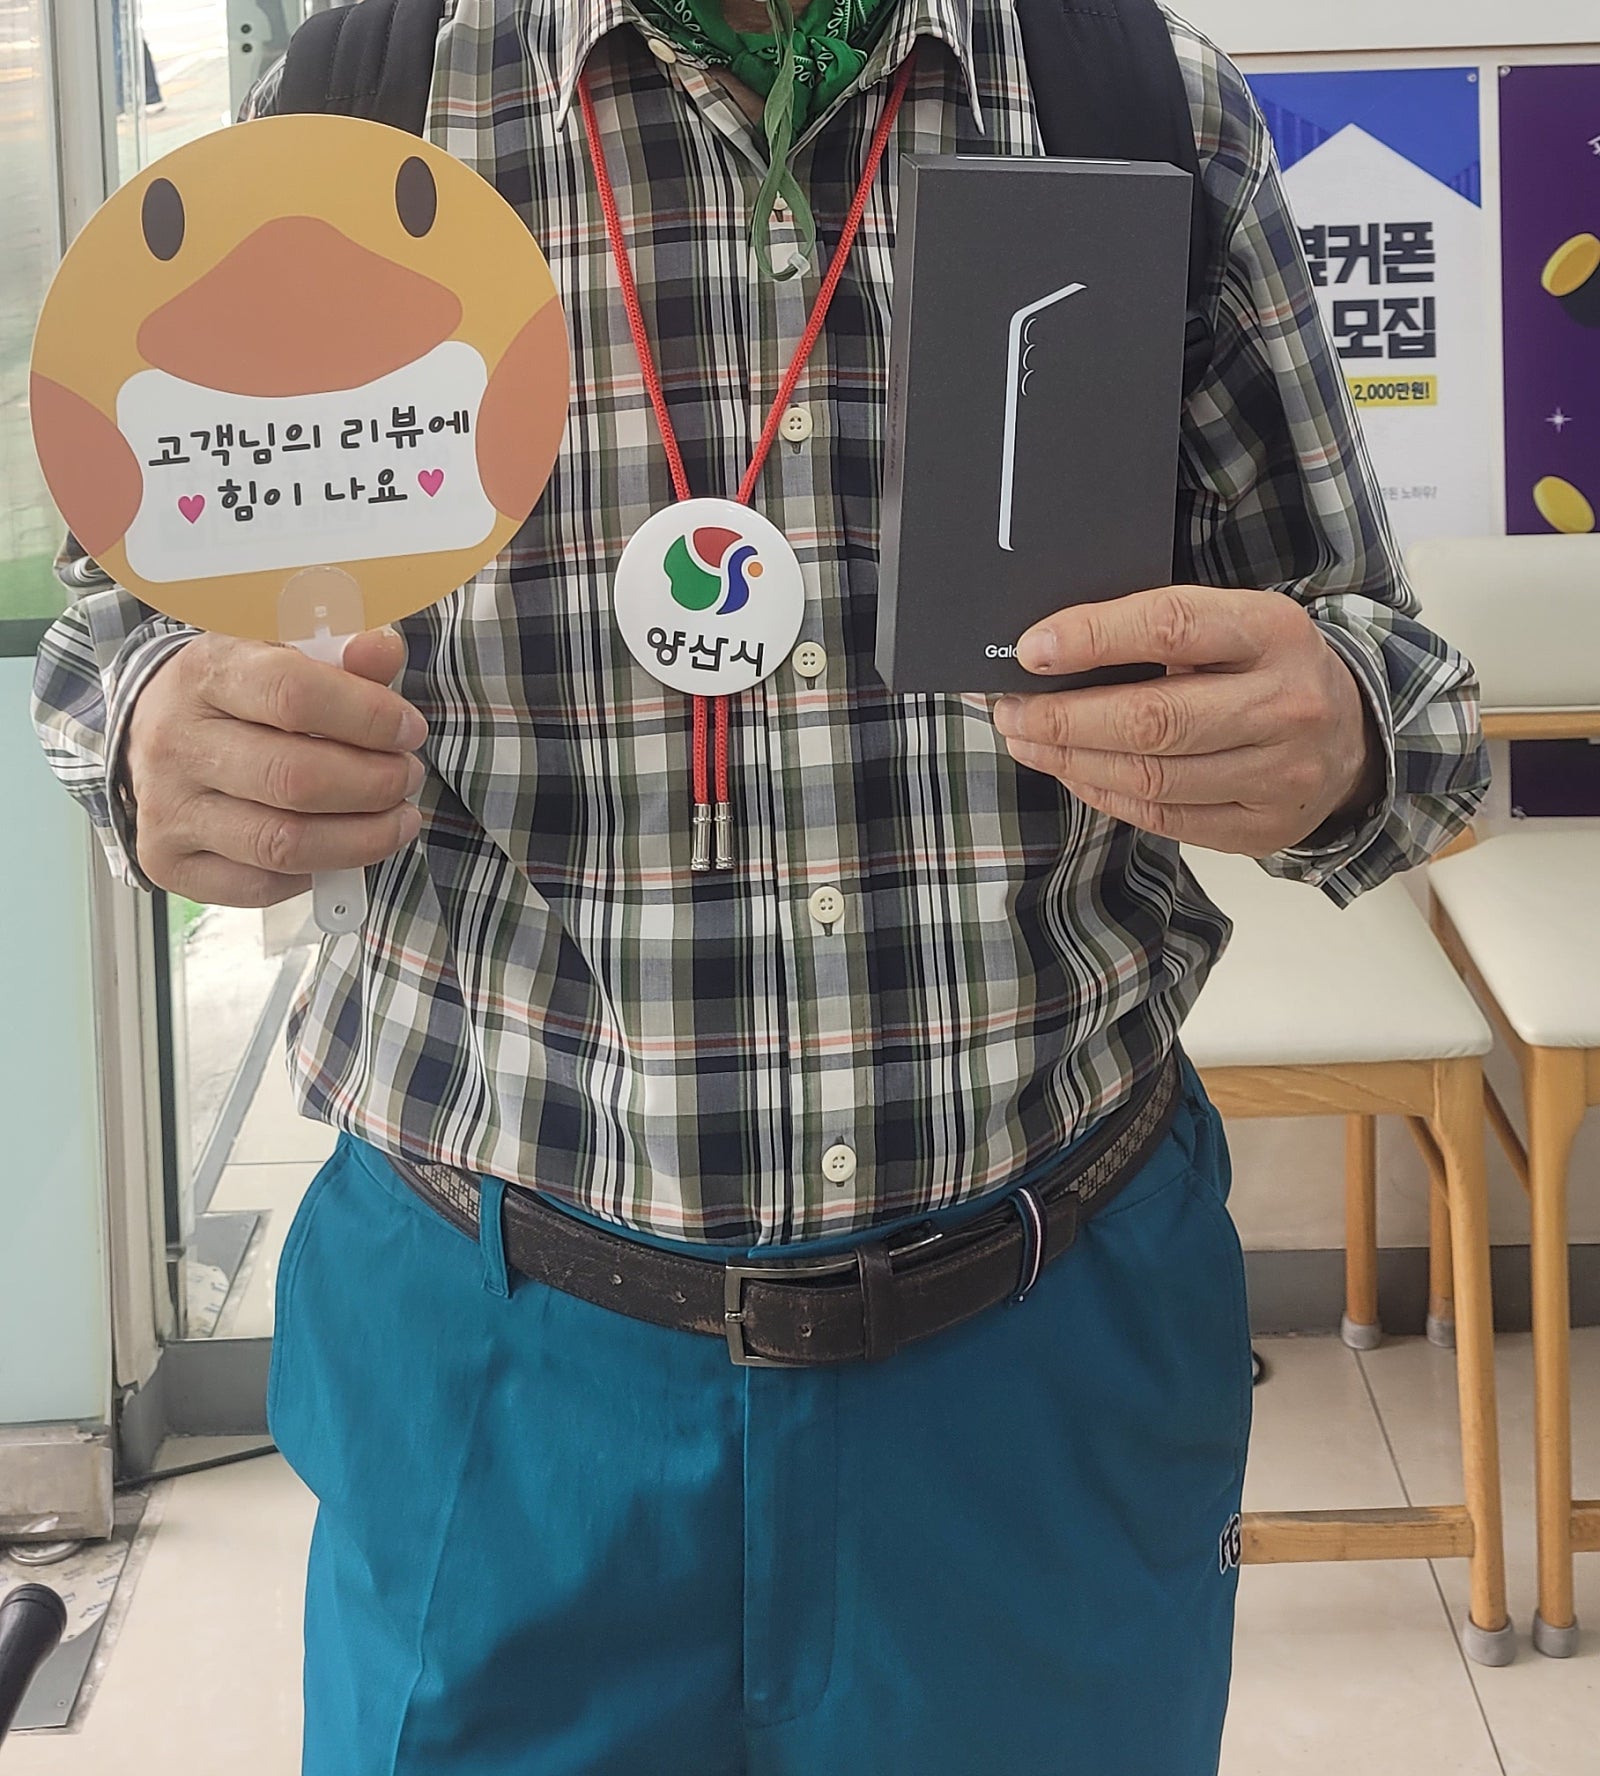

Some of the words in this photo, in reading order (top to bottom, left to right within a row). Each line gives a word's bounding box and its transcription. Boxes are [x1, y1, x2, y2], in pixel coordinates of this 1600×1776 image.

[1333, 296, 1436, 359] 모집
[1353, 381, 1430, 402] 2,000만원!
[148, 422, 321, 467] 고객님의
[341, 405, 470, 449] 리뷰에
[217, 479, 301, 522] 힘이
[325, 468, 408, 504] 나요
[647, 626, 764, 677] 양산시
